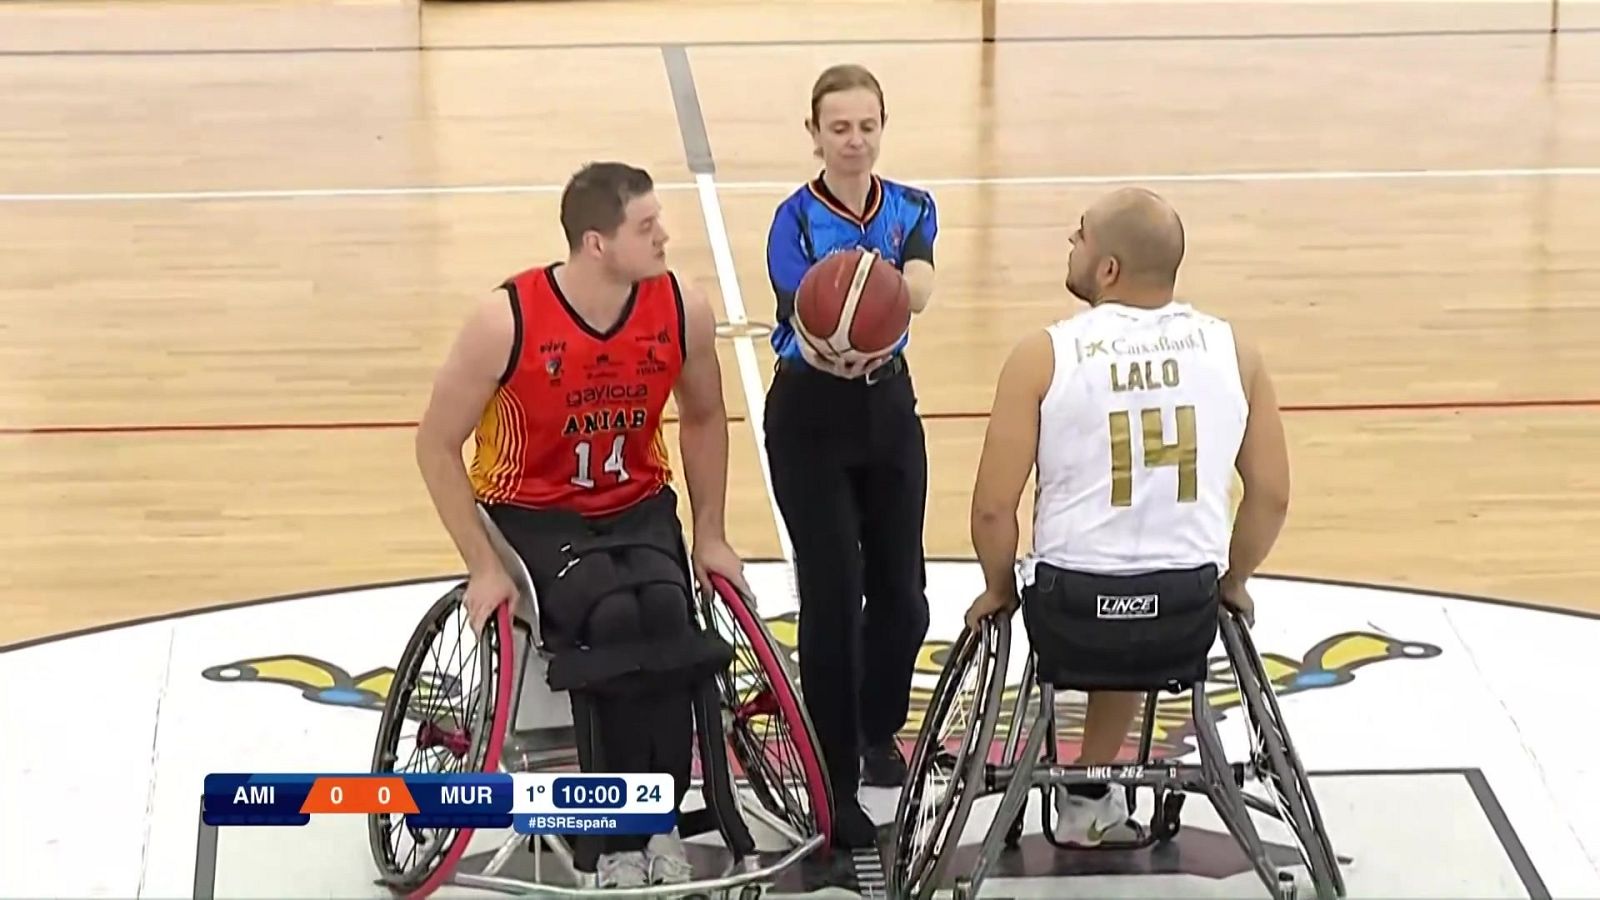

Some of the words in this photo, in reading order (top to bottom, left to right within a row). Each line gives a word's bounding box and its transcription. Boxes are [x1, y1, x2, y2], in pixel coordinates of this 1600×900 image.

[1110, 358, 1180, 392] LALO
[562, 408, 647, 437] ANIAB
[570, 434, 631, 490] 14
[1108, 405, 1198, 507] 14
[1100, 596, 1154, 613] LINCE
[1086, 765, 1112, 778] LINCE
